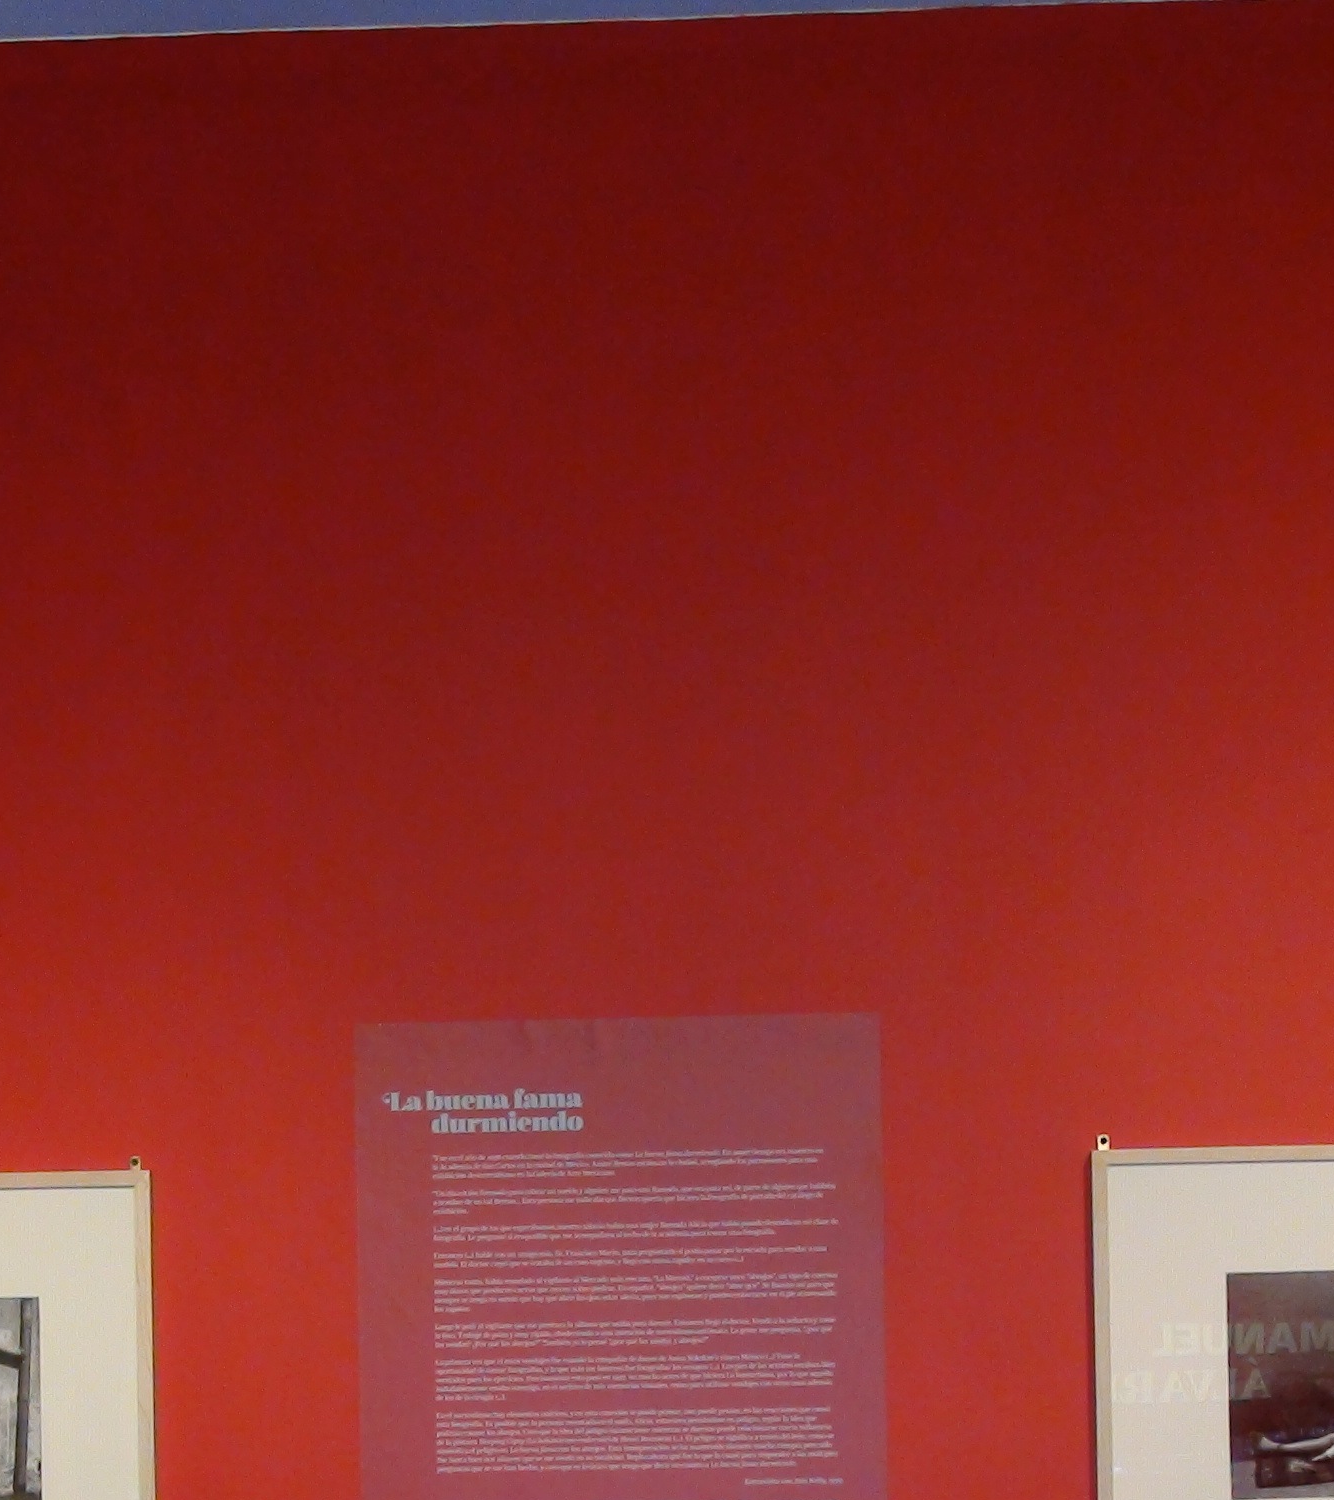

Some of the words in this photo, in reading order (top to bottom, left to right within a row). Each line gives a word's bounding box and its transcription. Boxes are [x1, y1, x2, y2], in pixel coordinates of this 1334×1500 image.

[426, 1089, 509, 1110] buena
[514, 1087, 583, 1109] fama
[431, 1111, 584, 1134] durmiendo
